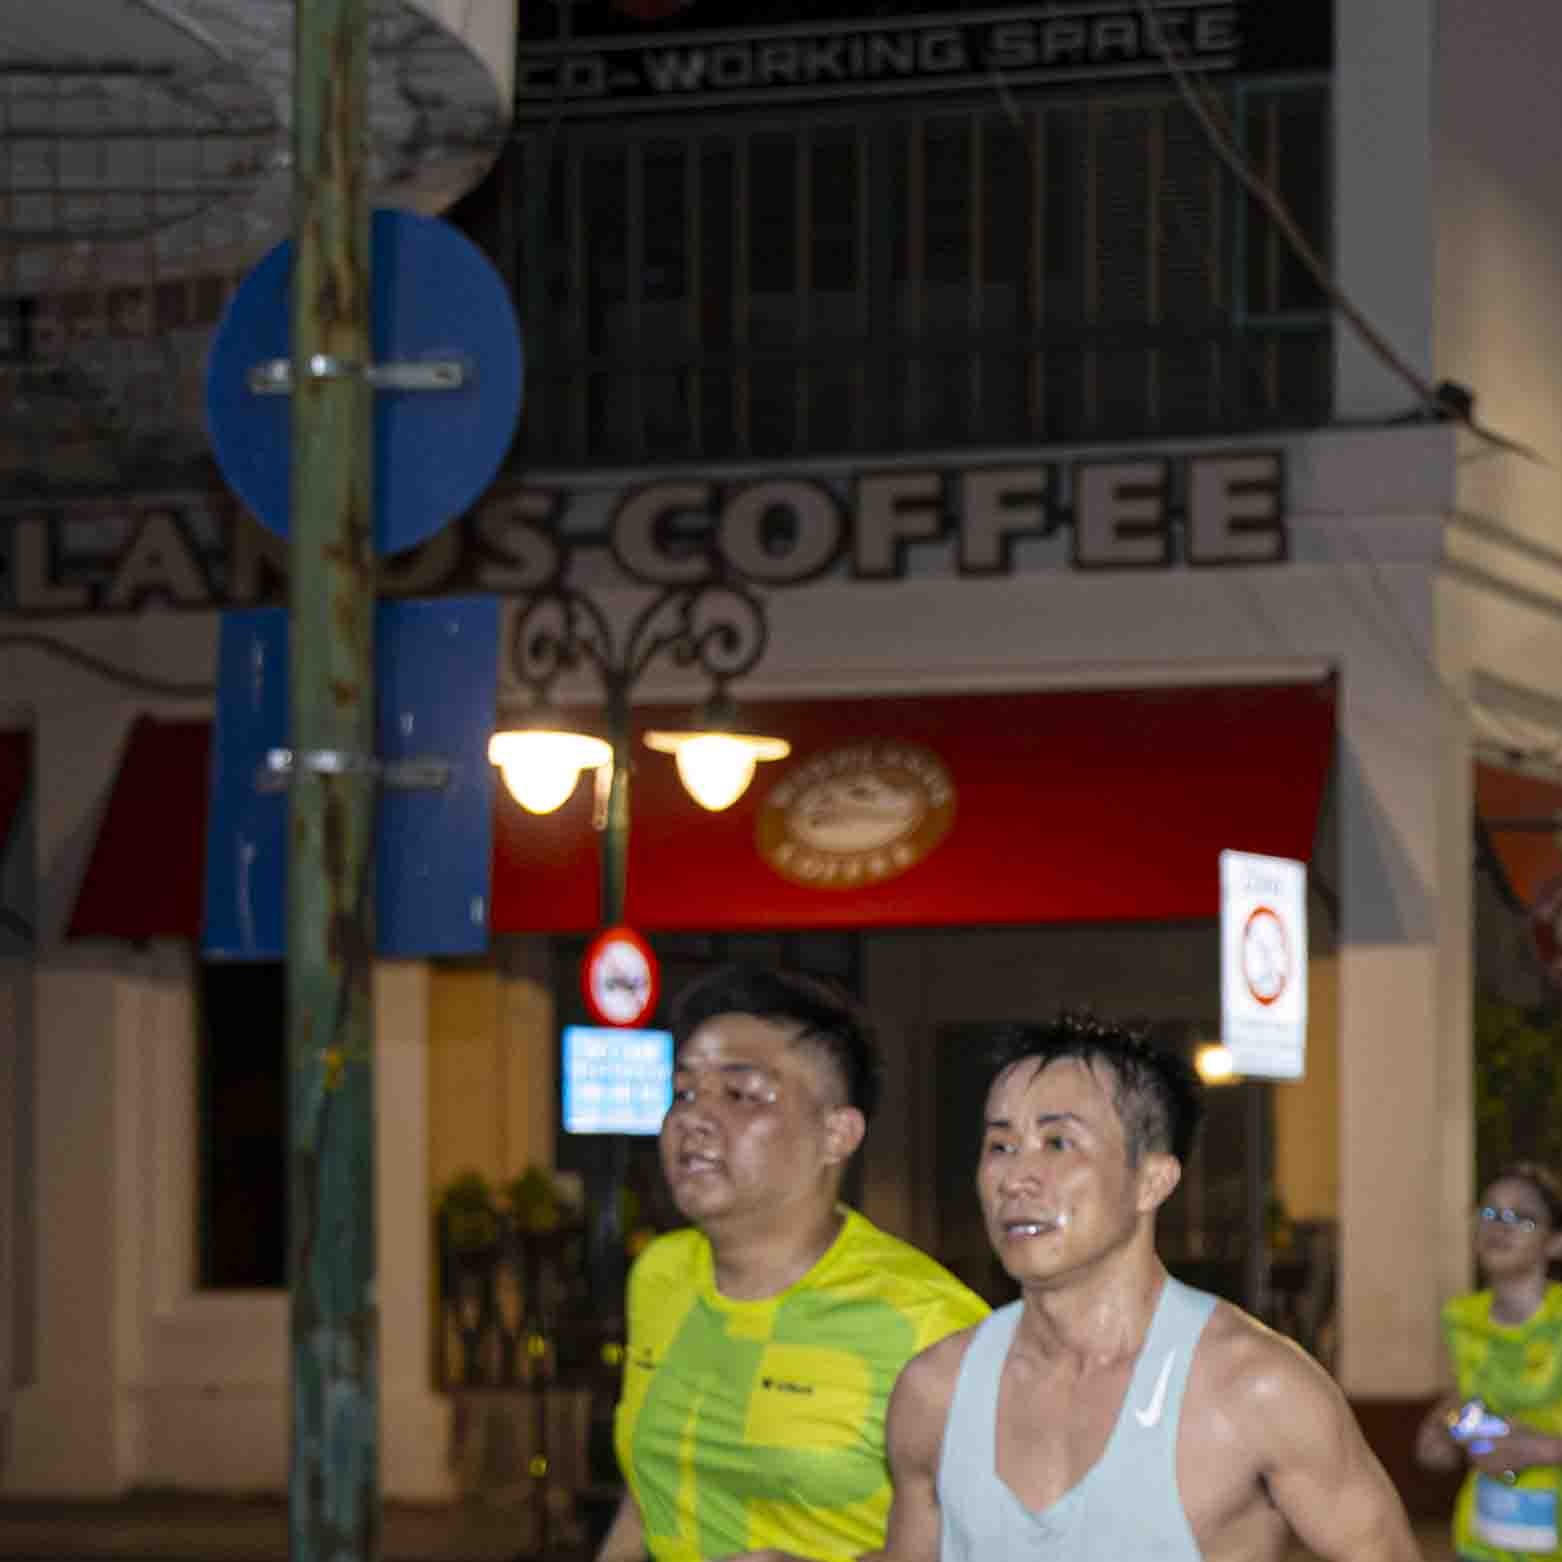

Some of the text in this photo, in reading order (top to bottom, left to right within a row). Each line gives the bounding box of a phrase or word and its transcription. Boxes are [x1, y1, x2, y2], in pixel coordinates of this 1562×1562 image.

[986, 11, 1241, 68] SPACE
[10, 449, 1286, 609] LAS COFFEE
